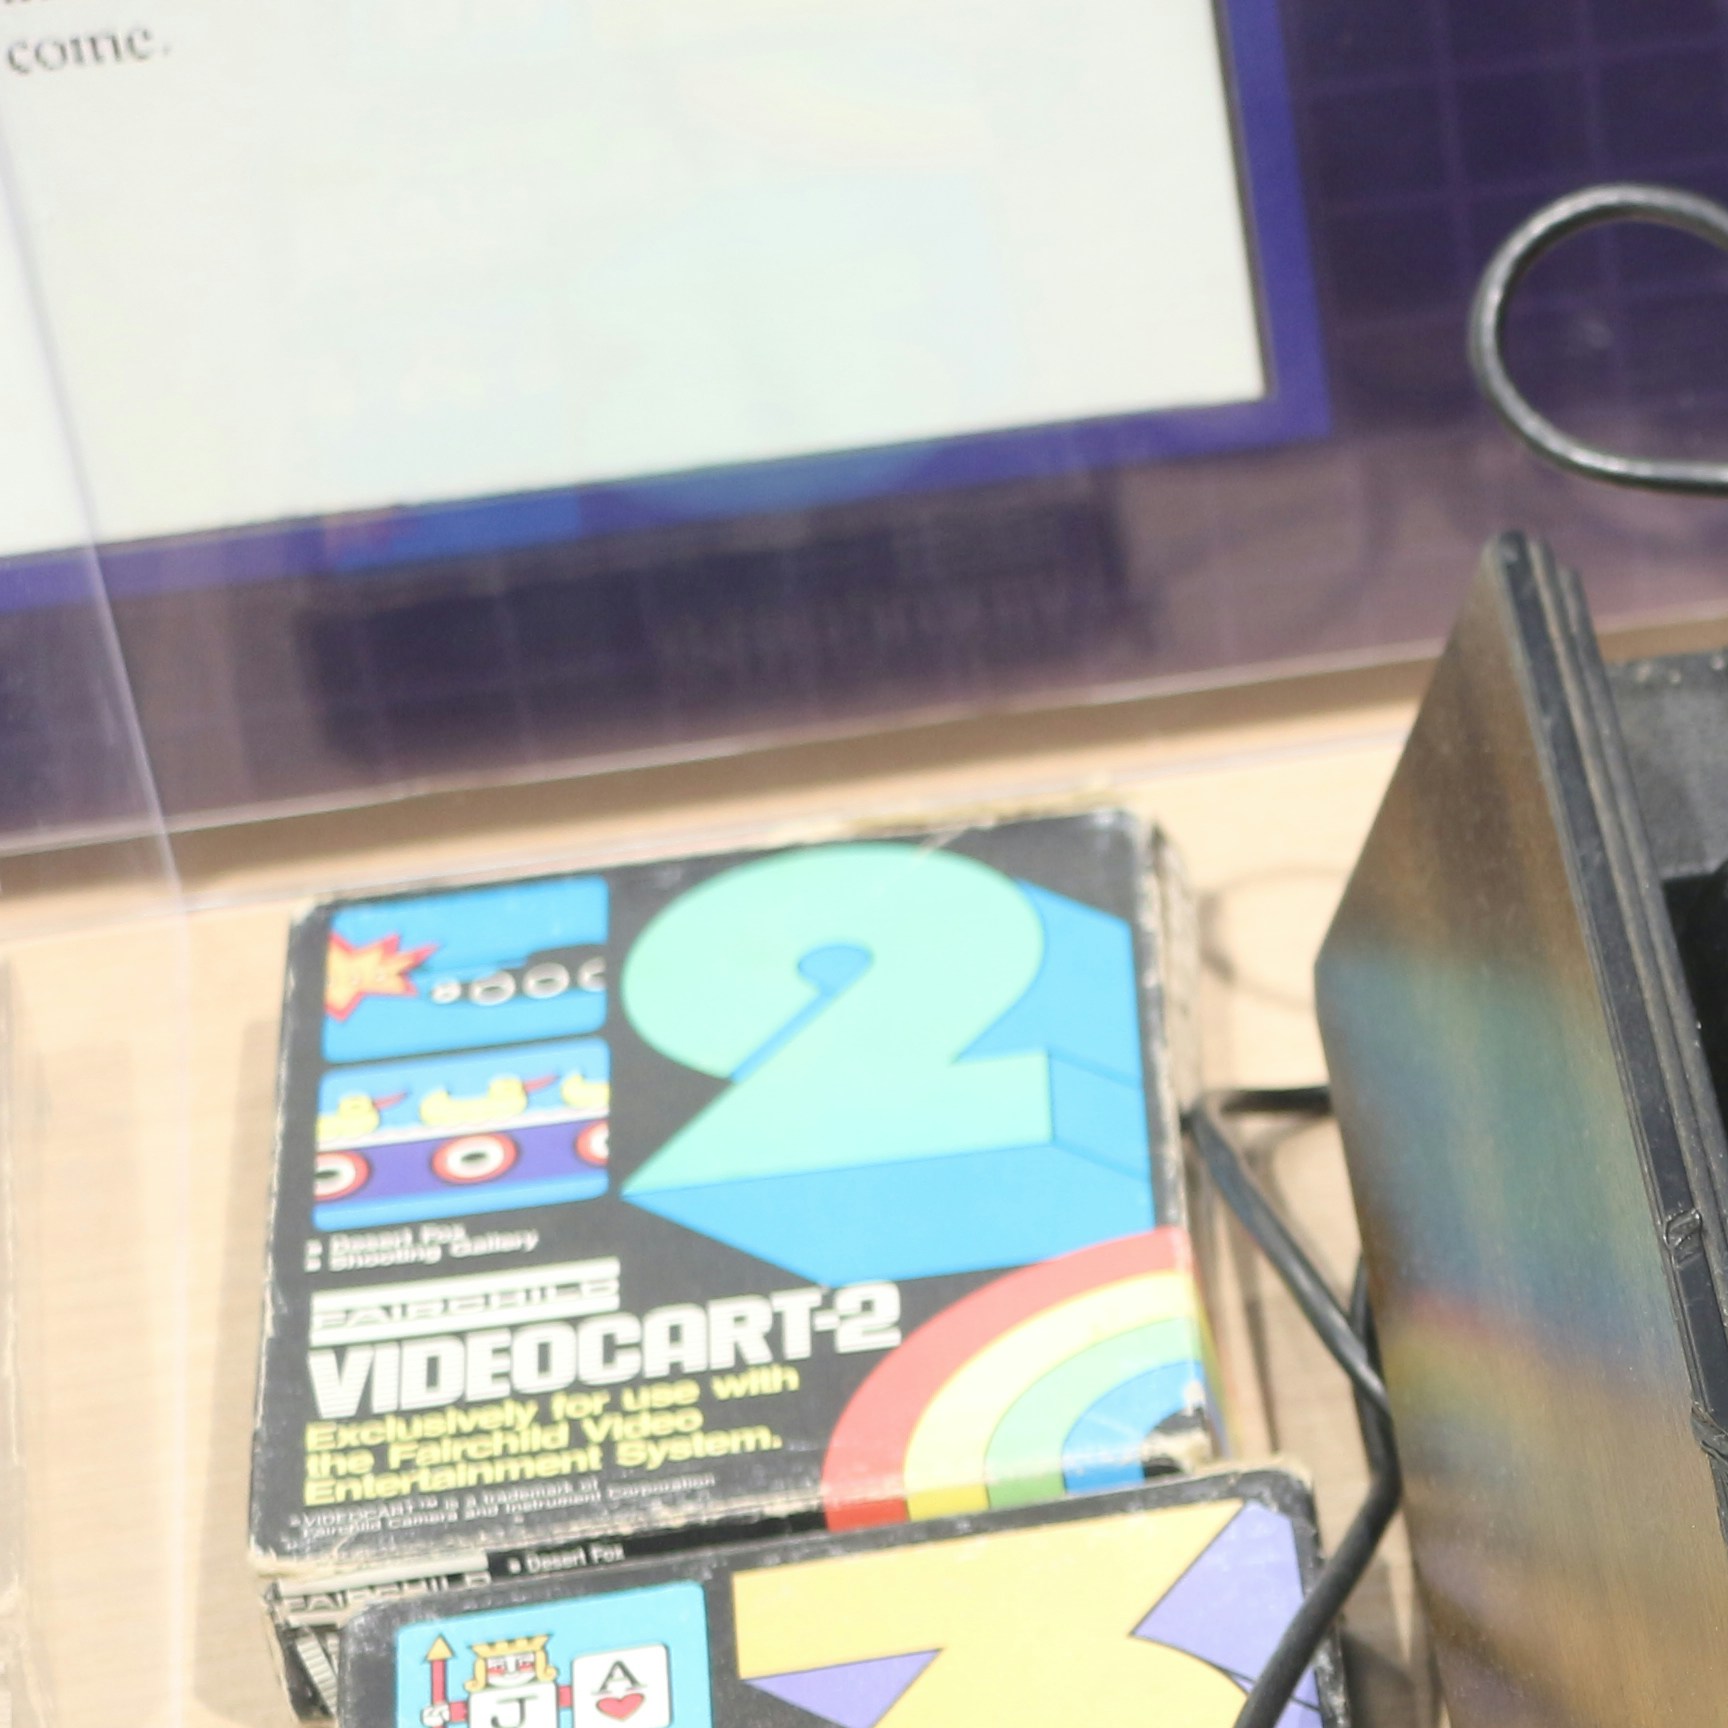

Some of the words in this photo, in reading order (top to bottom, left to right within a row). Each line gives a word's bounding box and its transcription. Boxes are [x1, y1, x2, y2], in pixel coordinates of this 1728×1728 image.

[7, 26, 172, 75] come.
[620, 843, 1053, 1196] 2
[451, 1228, 540, 1258] Gallery
[307, 1280, 901, 1419] VIDEOCART-2
[304, 1398, 539, 1451] Exclusively
[552, 1389, 611, 1421] for
[621, 1378, 701, 1412] use
[711, 1364, 800, 1400] with
[305, 1449, 375, 1476] the
[388, 1420, 570, 1470] Fairchild
[581, 1407, 704, 1443] Video
[304, 1444, 603, 1507] Entertainment
[616, 1424, 783, 1470] System.
